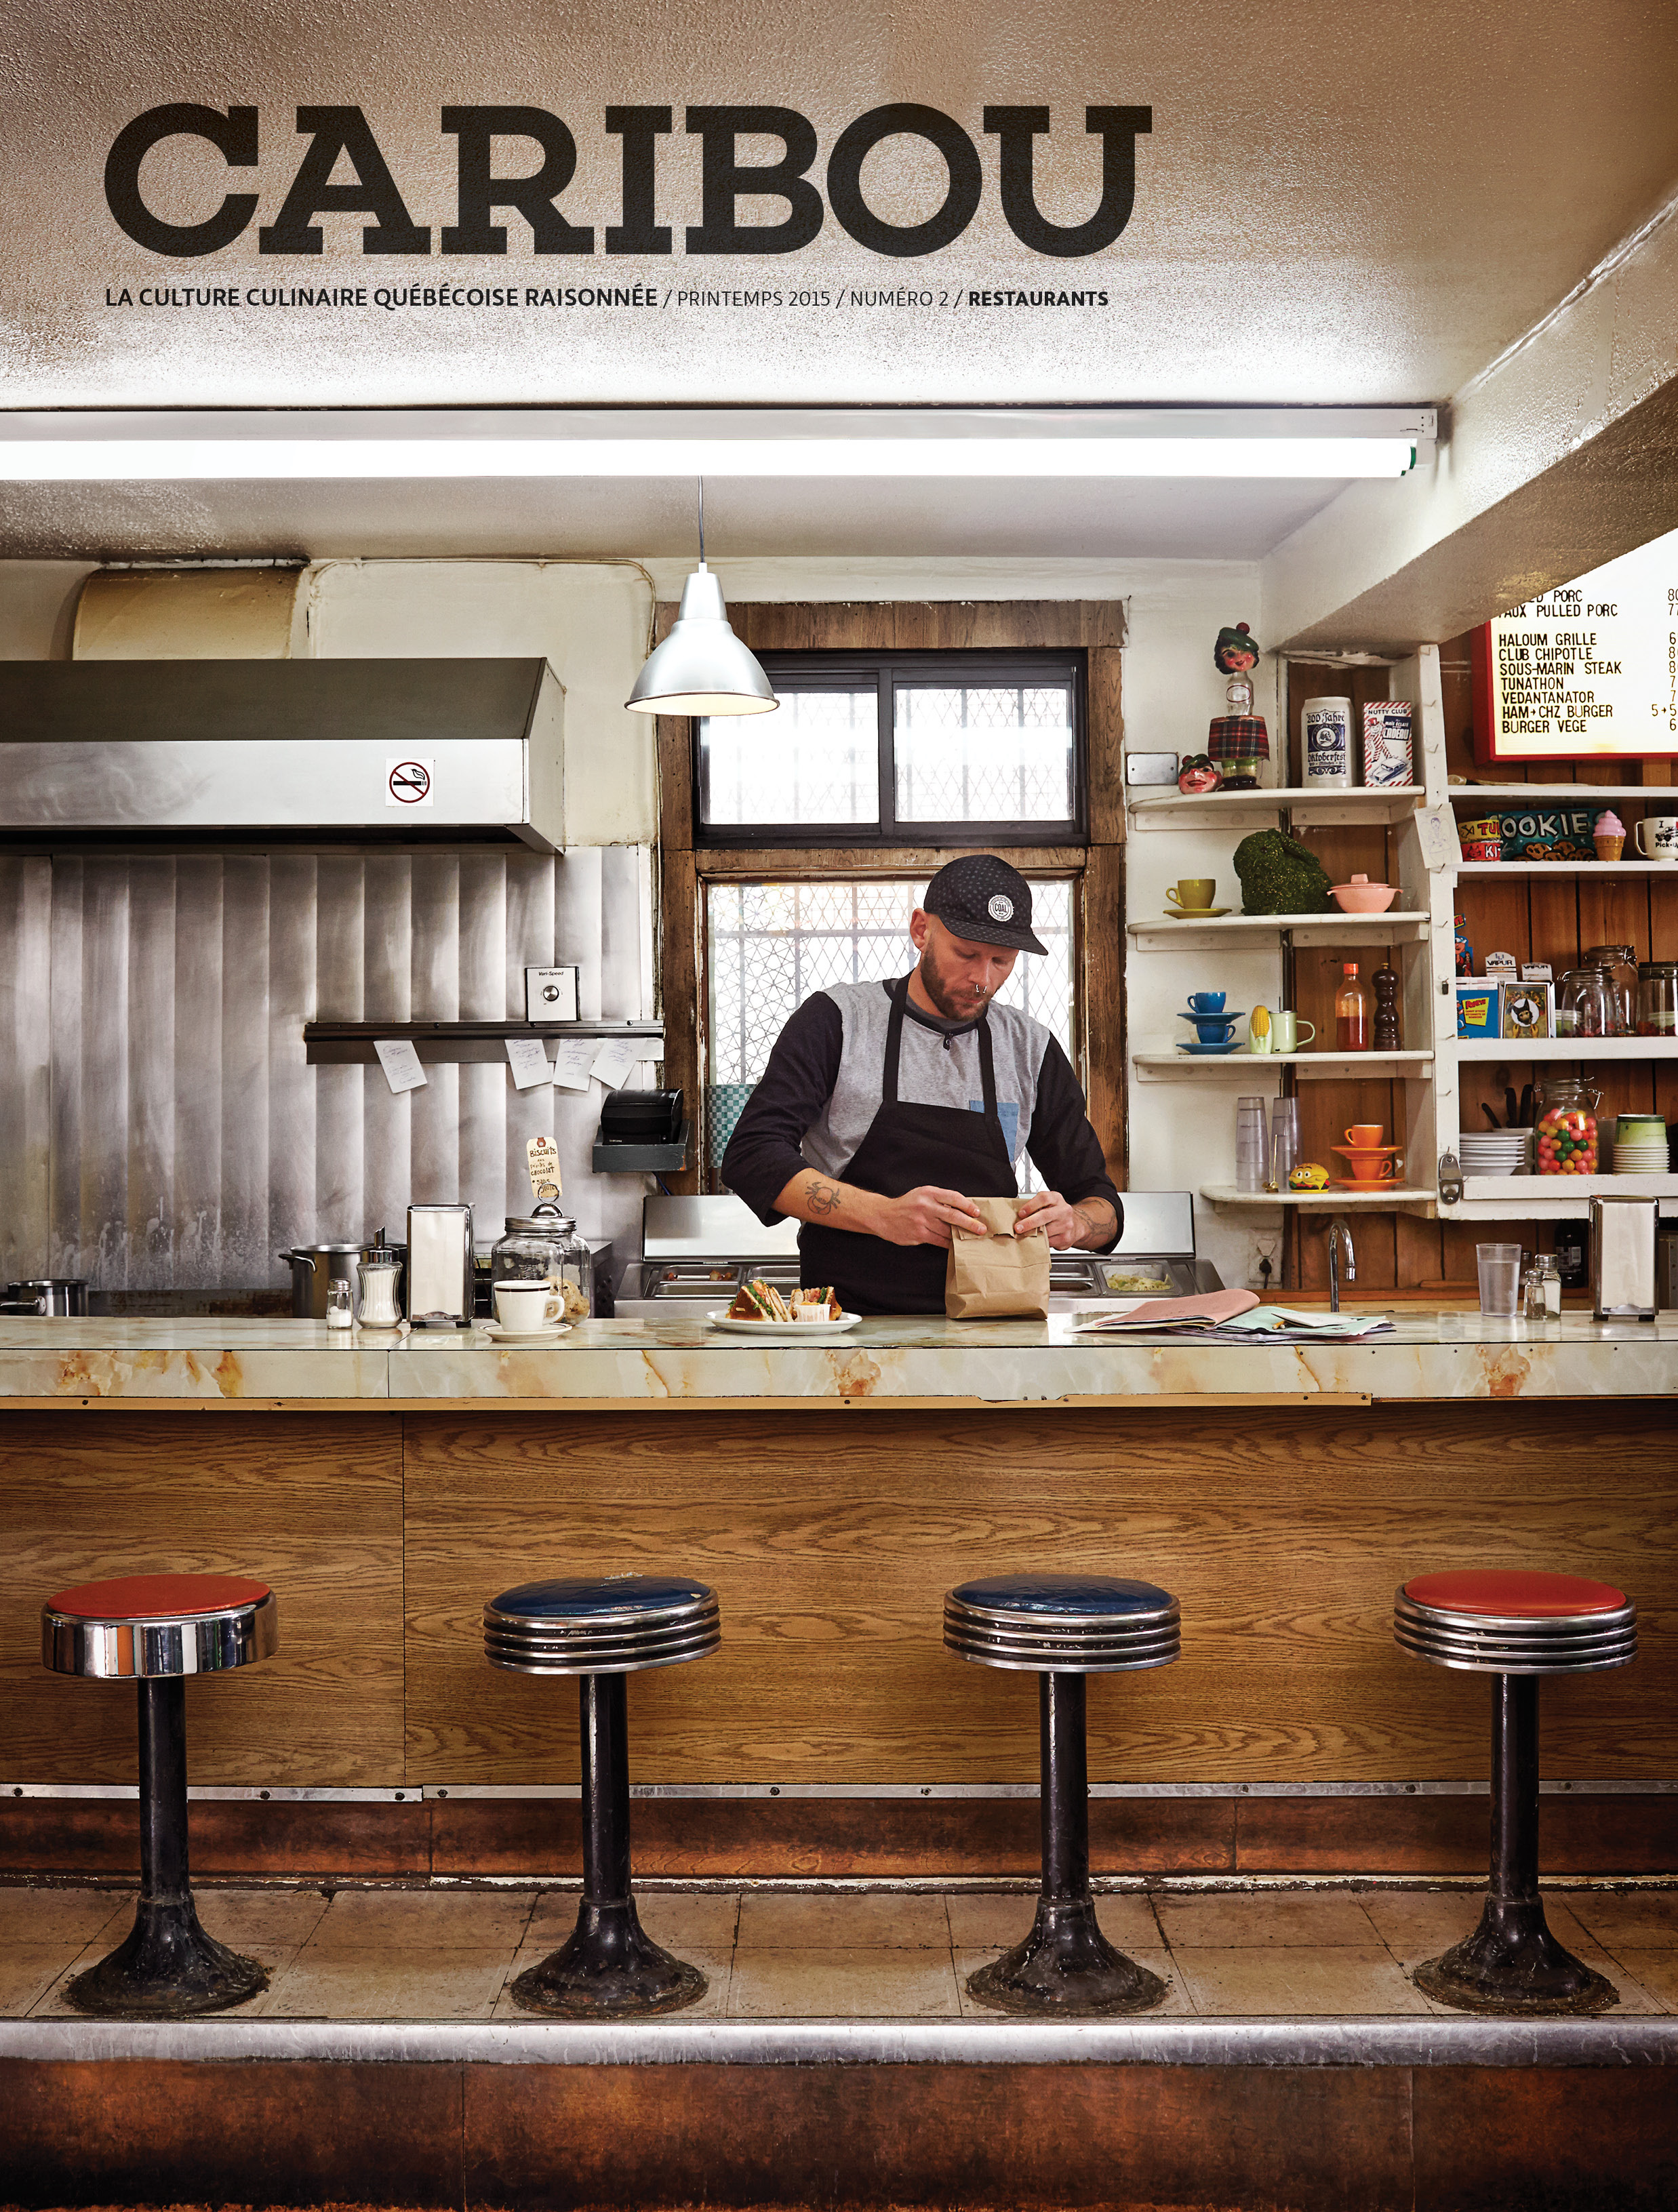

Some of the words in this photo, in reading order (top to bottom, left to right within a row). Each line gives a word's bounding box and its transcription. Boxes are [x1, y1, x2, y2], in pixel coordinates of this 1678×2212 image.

[1554, 590, 1582, 602] PORC
[1537, 605, 1580, 617] PULLED
[1587, 604, 1618, 617] PORC
[1499, 633, 1548, 647] HALOUM
[1555, 633, 1597, 645] GRILLE
[1499, 648, 1530, 661] CLUB
[1536, 647, 1593, 660] CHIPOTLE
[1500, 662, 1574, 676] SOUS-MARIN
[1584, 661, 1622, 675] STEAK
[1501, 677, 1563, 691] TUNATHON
[1502, 691, 1594, 704] VEDANTANATOR
[1567, 705, 1613, 718] BURGER
[1307, 714, 1321, 723] 200
[1502, 720, 1549, 733] BURGER
[1557, 720, 1587, 733] VEGE
[1489, 813, 1605, 839] OOKIE
[995, 903, 1007, 912] COAL
